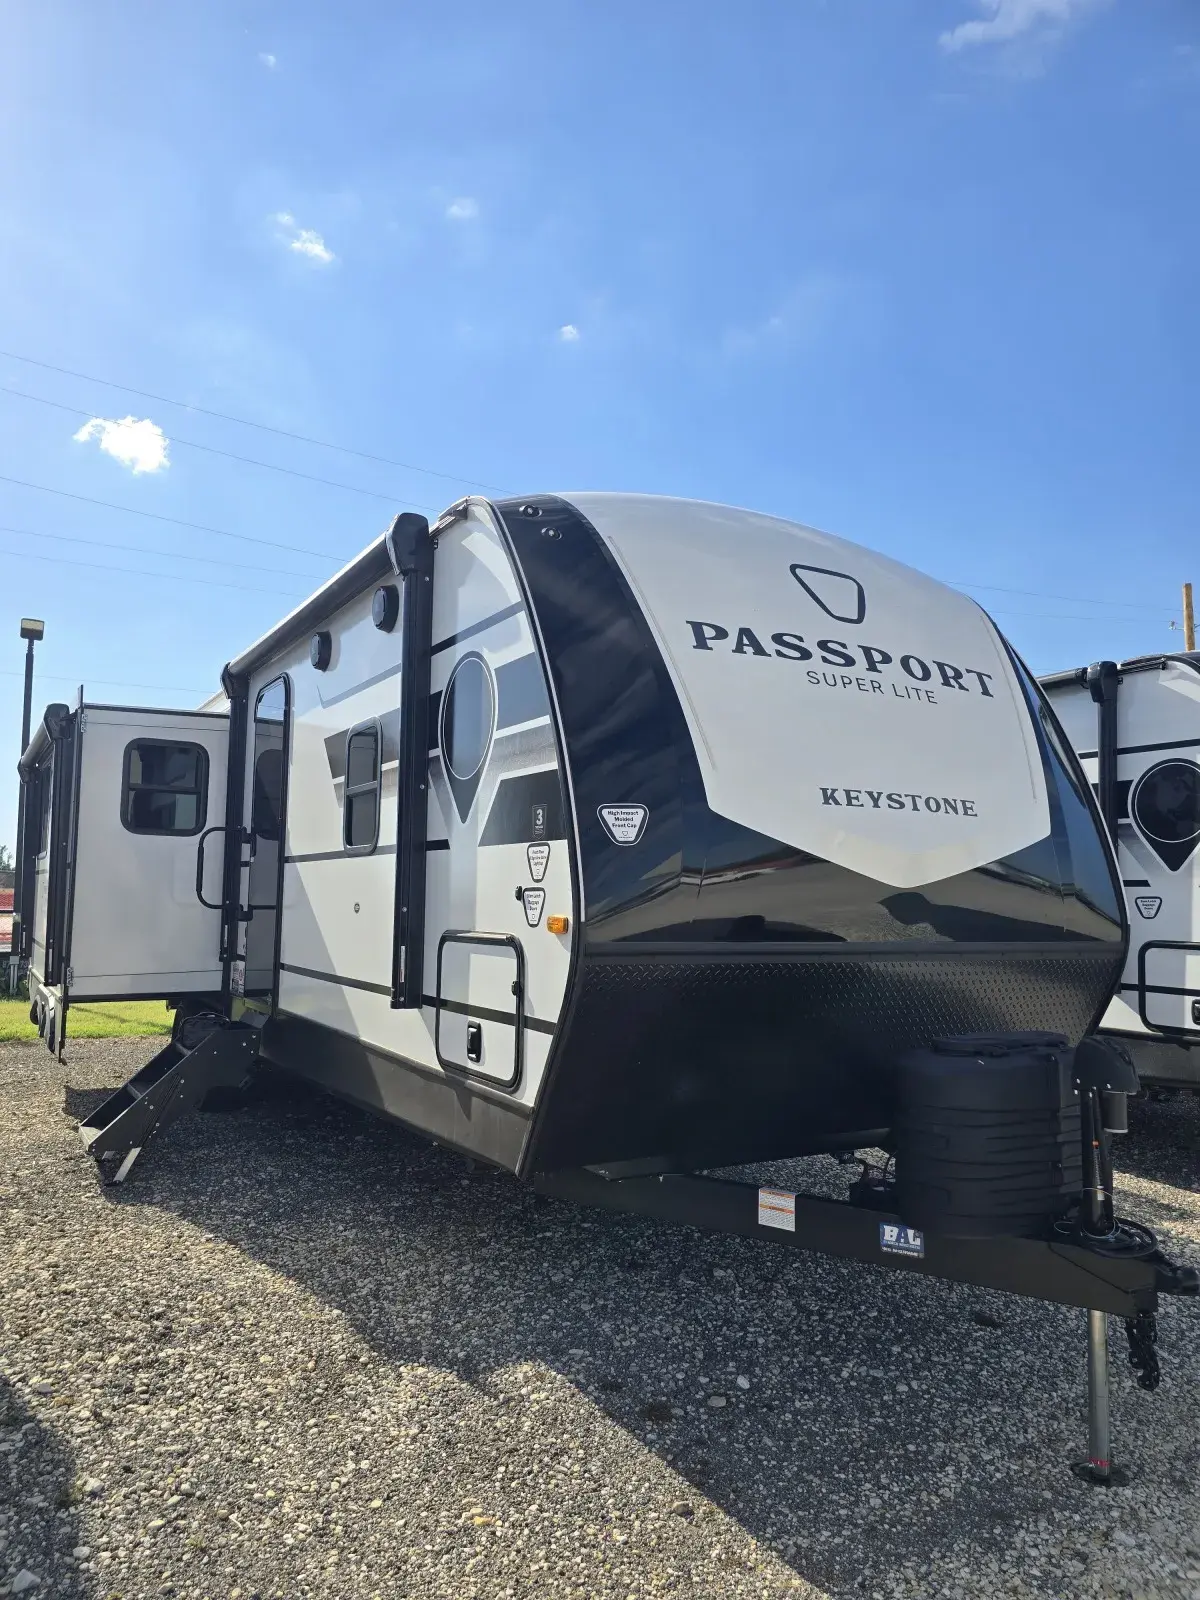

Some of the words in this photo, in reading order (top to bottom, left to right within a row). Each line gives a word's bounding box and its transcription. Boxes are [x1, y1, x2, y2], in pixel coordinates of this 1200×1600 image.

[686, 620, 994, 698] PASSPORT
[806, 670, 884, 695] SUPER
[891, 683, 938, 705] LITE
[536, 808, 543, 825] 3
[819, 787, 978, 818] KEYSTONE
